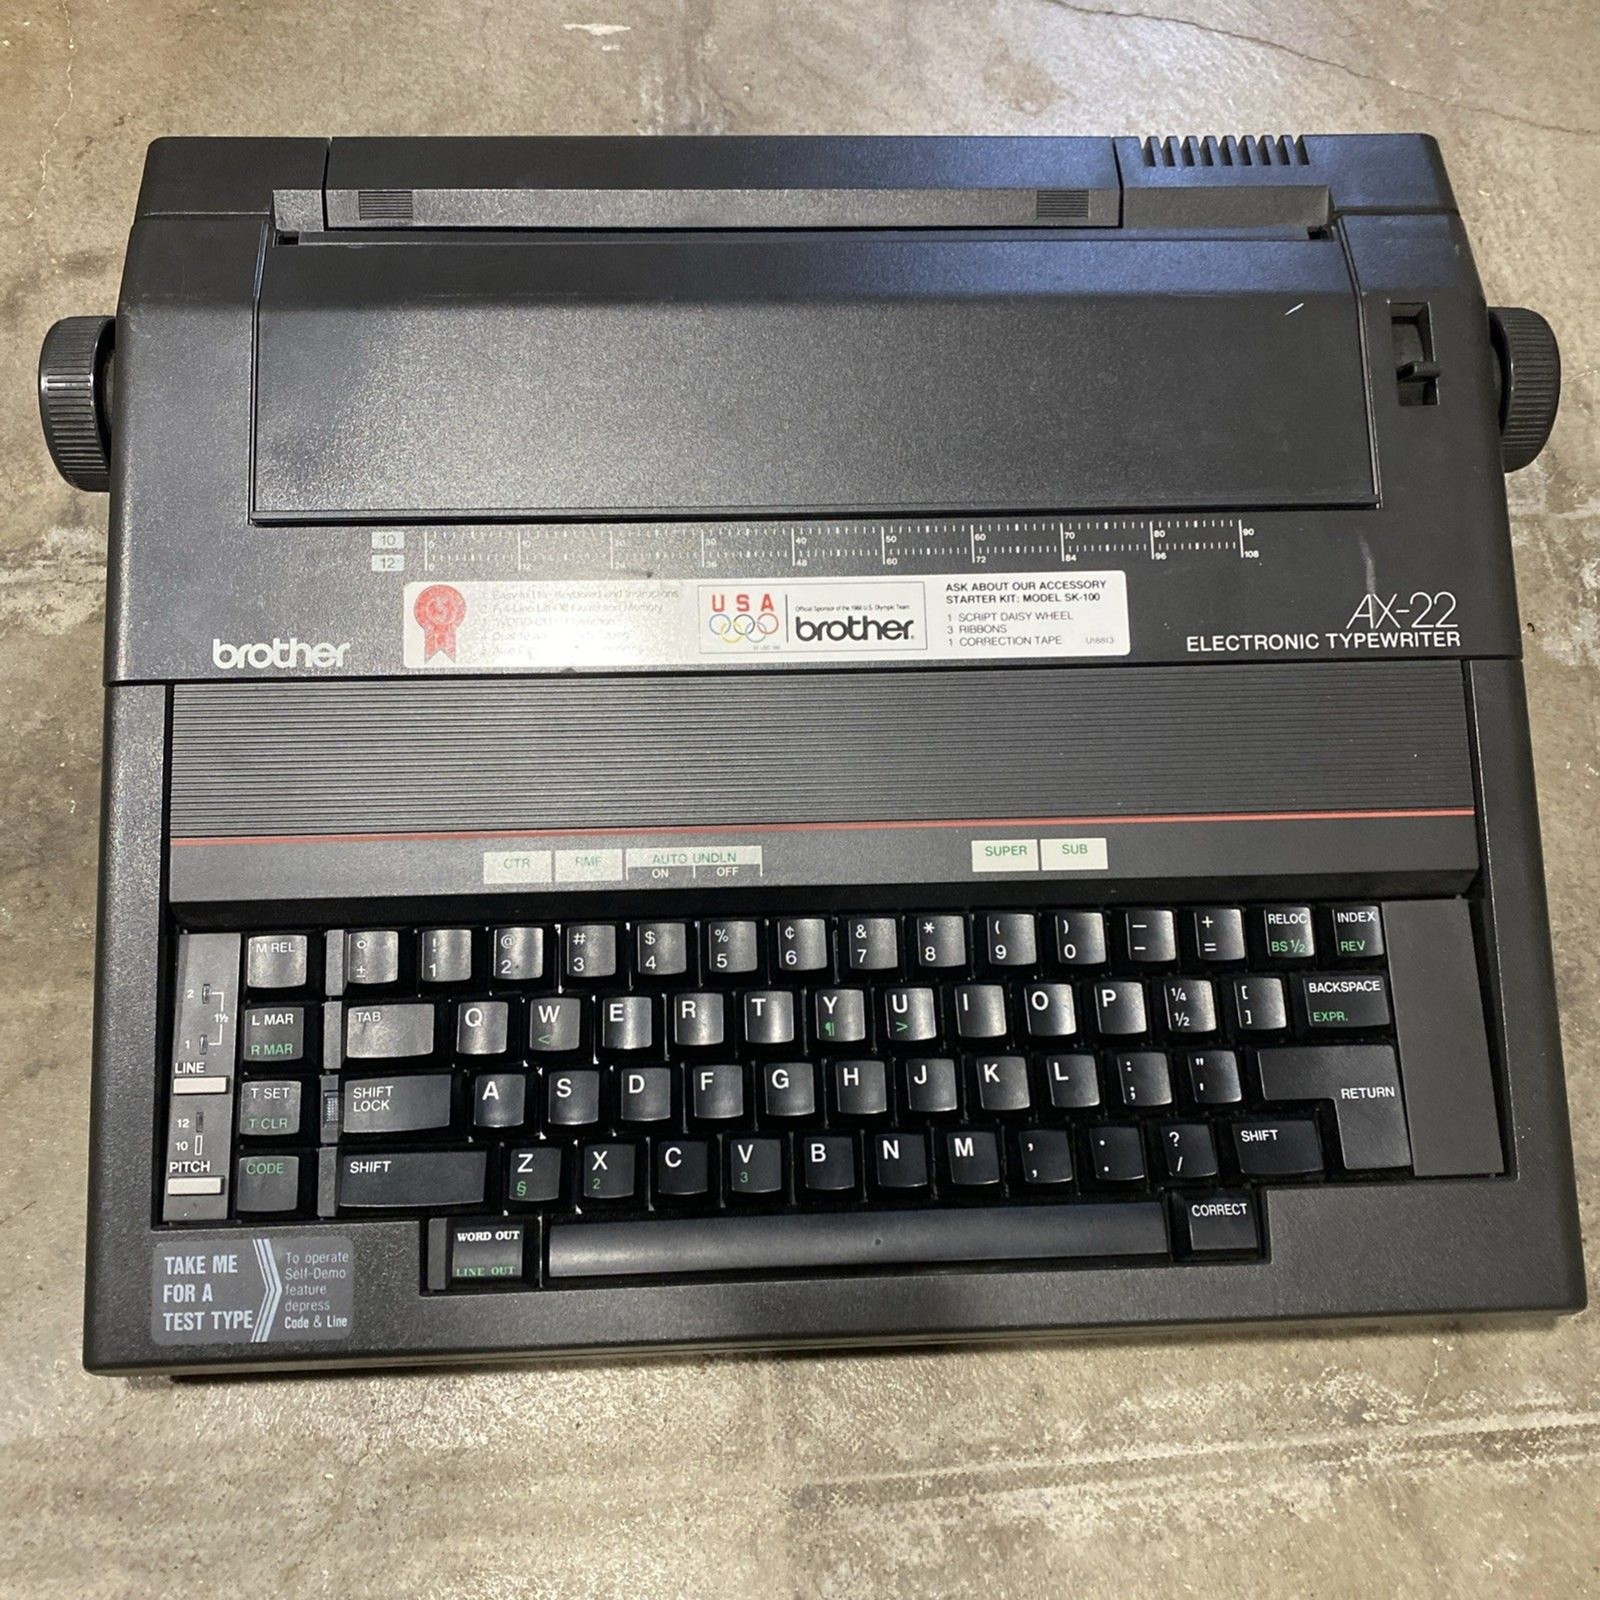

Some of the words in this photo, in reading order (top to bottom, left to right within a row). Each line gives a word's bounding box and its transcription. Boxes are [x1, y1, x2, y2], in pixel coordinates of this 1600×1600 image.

[382, 534, 395, 546] 10
[1154, 530, 1165, 538] 80
[381, 558, 395, 569] 12
[1065, 554, 1077, 562] 84
[946, 583, 968, 592] ASK
[971, 582, 1009, 591] ABOUT
[1012, 582, 1035, 591] OUR
[1039, 580, 1106, 590] ACCESSORY
[946, 595, 996, 604] STARTER
[999, 594, 1020, 603] KIT:
[1023, 594, 1061, 603] MODEL
[1064, 593, 1100, 602] SK-100
[958, 613, 997, 622] SCRIPT
[1000, 612, 1032, 621] DAISY
[1035, 611, 1073, 620] WHEEL
[1346, 592, 1458, 629] AX-22
[795, 615, 914, 641] brother
[959, 625, 1007, 634] RIBBONS
[960, 636, 1031, 647] CORRECTION
[1034, 636, 1062, 645] TAPE
[1187, 633, 1319, 652] ELECTRONIC
[1325, 631, 1461, 649] TYPEWRITER
[212, 638, 351, 669] brother
[985, 845, 1028, 857] SUPER
[1062, 844, 1088, 855] SUB
[503, 857, 530, 869] CTR
[652, 853, 687, 865] AUTO
[693, 852, 737, 864] UNDLN
[652, 866, 669, 878] ON
[717, 866, 739, 877] OFF
[1268, 913, 1308, 925] RELOC
[1337, 911, 1377, 923] INDEX
[256, 943, 267, 953] M
[271, 942, 295, 953] REL
[995, 944, 1007, 960] 9
[1064, 943, 1076, 959] 0
[1271, 941, 1288, 952] BS
[1341, 940, 1366, 951] REV
[785, 950, 797, 965] 6
[857, 949, 868, 963] 7
[925, 946, 936, 961] 8
[501, 960, 512, 974] 2
[573, 957, 585, 972] 3
[645, 956, 657, 970] 4
[716, 954, 728, 968] 5
[429, 963, 437, 977] 1
[187, 989, 194, 998] 2
[1309, 980, 1381, 993] BACKSPACE
[822, 996, 838, 1014] Y
[892, 994, 908, 1013] U
[1031, 991, 1049, 1011] O
[1102, 989, 1117, 1007] P
[538, 1005, 561, 1023] W
[610, 1003, 624, 1022] E
[682, 1000, 696, 1018] R
[751, 998, 766, 1016] T
[252, 1014, 260, 1025] L
[264, 1013, 294, 1025] MAR
[356, 1011, 381, 1022] TAB
[465, 1008, 483, 1028] Q
[1313, 1011, 1349, 1022] EXPR.
[251, 1044, 260, 1055] R
[264, 1043, 293, 1055] MAR
[175, 1062, 205, 1074] LINE
[913, 1064, 927, 1085] J
[983, 1063, 1000, 1083] K
[1054, 1062, 1069, 1081] L
[701, 1072, 714, 1091] F
[771, 1069, 789, 1089] G
[843, 1067, 859, 1086] H
[482, 1081, 500, 1100] A
[556, 1078, 572, 1098] S
[629, 1074, 645, 1094] D
[251, 1088, 260, 1099] T
[264, 1087, 290, 1099] SET
[353, 1085, 394, 1099] SHIFT
[1341, 1086, 1395, 1100] RETURN
[353, 1099, 390, 1112] LOCK
[177, 1119, 190, 1129] 12
[249, 1119, 258, 1129] T
[261, 1118, 288, 1129] CLR
[1241, 1129, 1278, 1142] SHIFT
[175, 1141, 188, 1151] 10
[811, 1143, 827, 1162] B
[883, 1140, 899, 1160] N
[954, 1137, 974, 1157] M
[665, 1147, 682, 1168] C
[737, 1144, 754, 1163] V
[169, 1161, 211, 1173] PITCH
[349, 1161, 392, 1174] SHIFT
[517, 1153, 533, 1173] Z
[592, 1151, 608, 1171] X
[246, 1162, 284, 1175] CODE
[592, 1178, 601, 1189] 2
[740, 1171, 748, 1183] 3
[1191, 1203, 1247, 1217] CORRECT
[457, 1231, 492, 1242] WORD
[495, 1231, 520, 1241] OUT
[164, 1256, 206, 1275] TAKE
[213, 1255, 238, 1274] ME
[286, 1252, 299, 1265] To
[305, 1251, 349, 1266] operate
[285, 1268, 346, 1281] Self-Demo
[456, 1267, 485, 1277] LINE
[491, 1266, 516, 1275] OUT
[163, 1284, 195, 1303] FOR
[202, 1283, 213, 1302] A
[285, 1283, 327, 1296] feature
[285, 1300, 330, 1314] depress
[163, 1312, 205, 1331] TEST
[211, 1310, 253, 1330] TYPE
[284, 1316, 309, 1329] Code
[313, 1316, 322, 1328] &
[327, 1315, 347, 1328] Line
